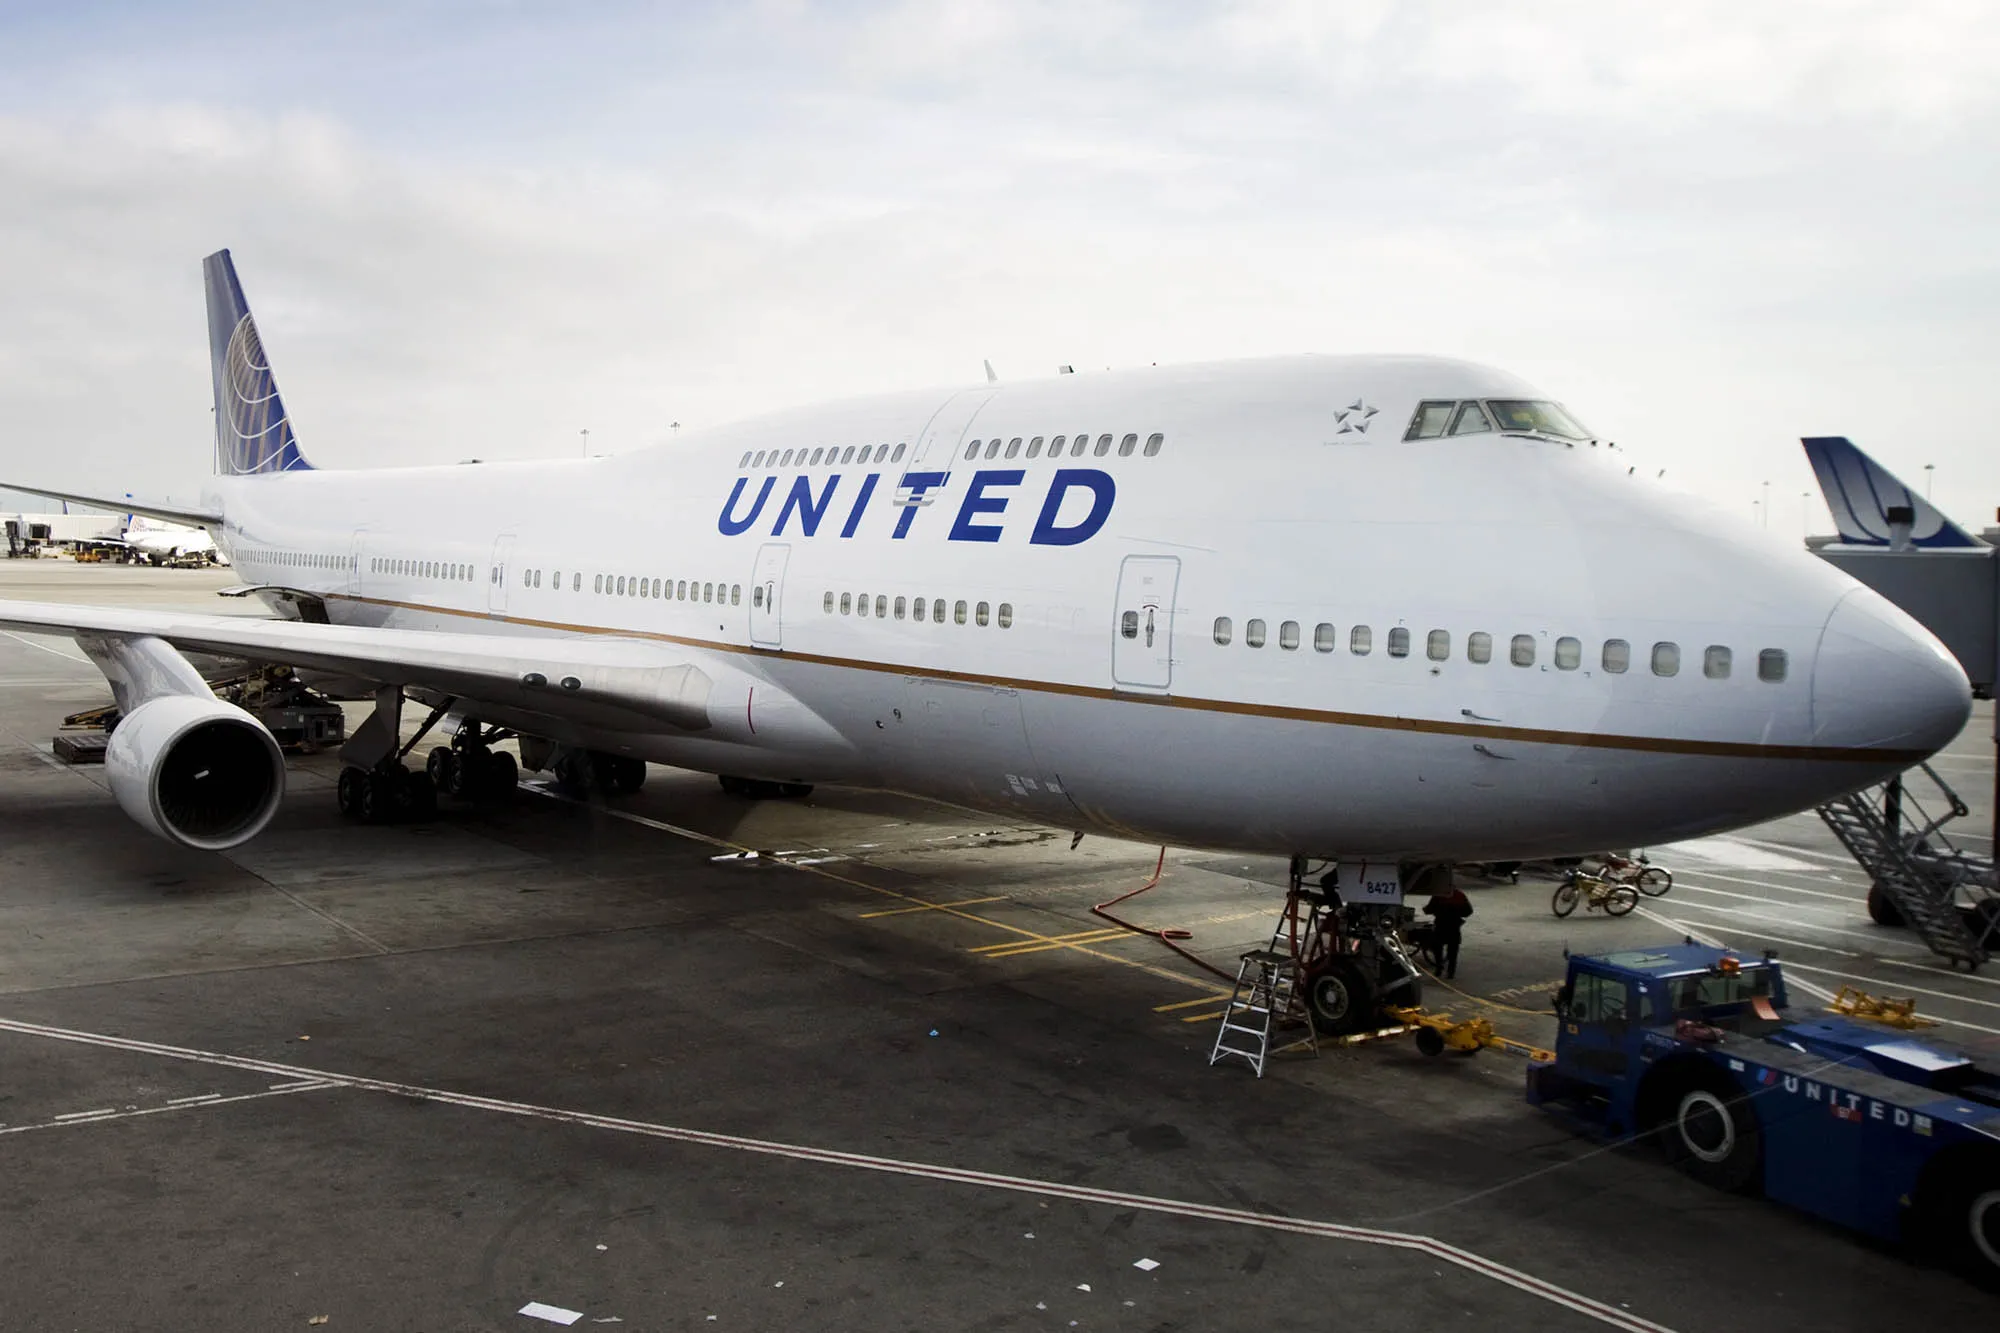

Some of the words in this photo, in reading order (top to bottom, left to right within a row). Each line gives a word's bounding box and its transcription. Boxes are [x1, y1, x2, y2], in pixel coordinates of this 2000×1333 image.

[718, 469, 1117, 546] UNITED
[1367, 881, 1396, 894] 8427
[1784, 1075, 1910, 1127] UNITED
